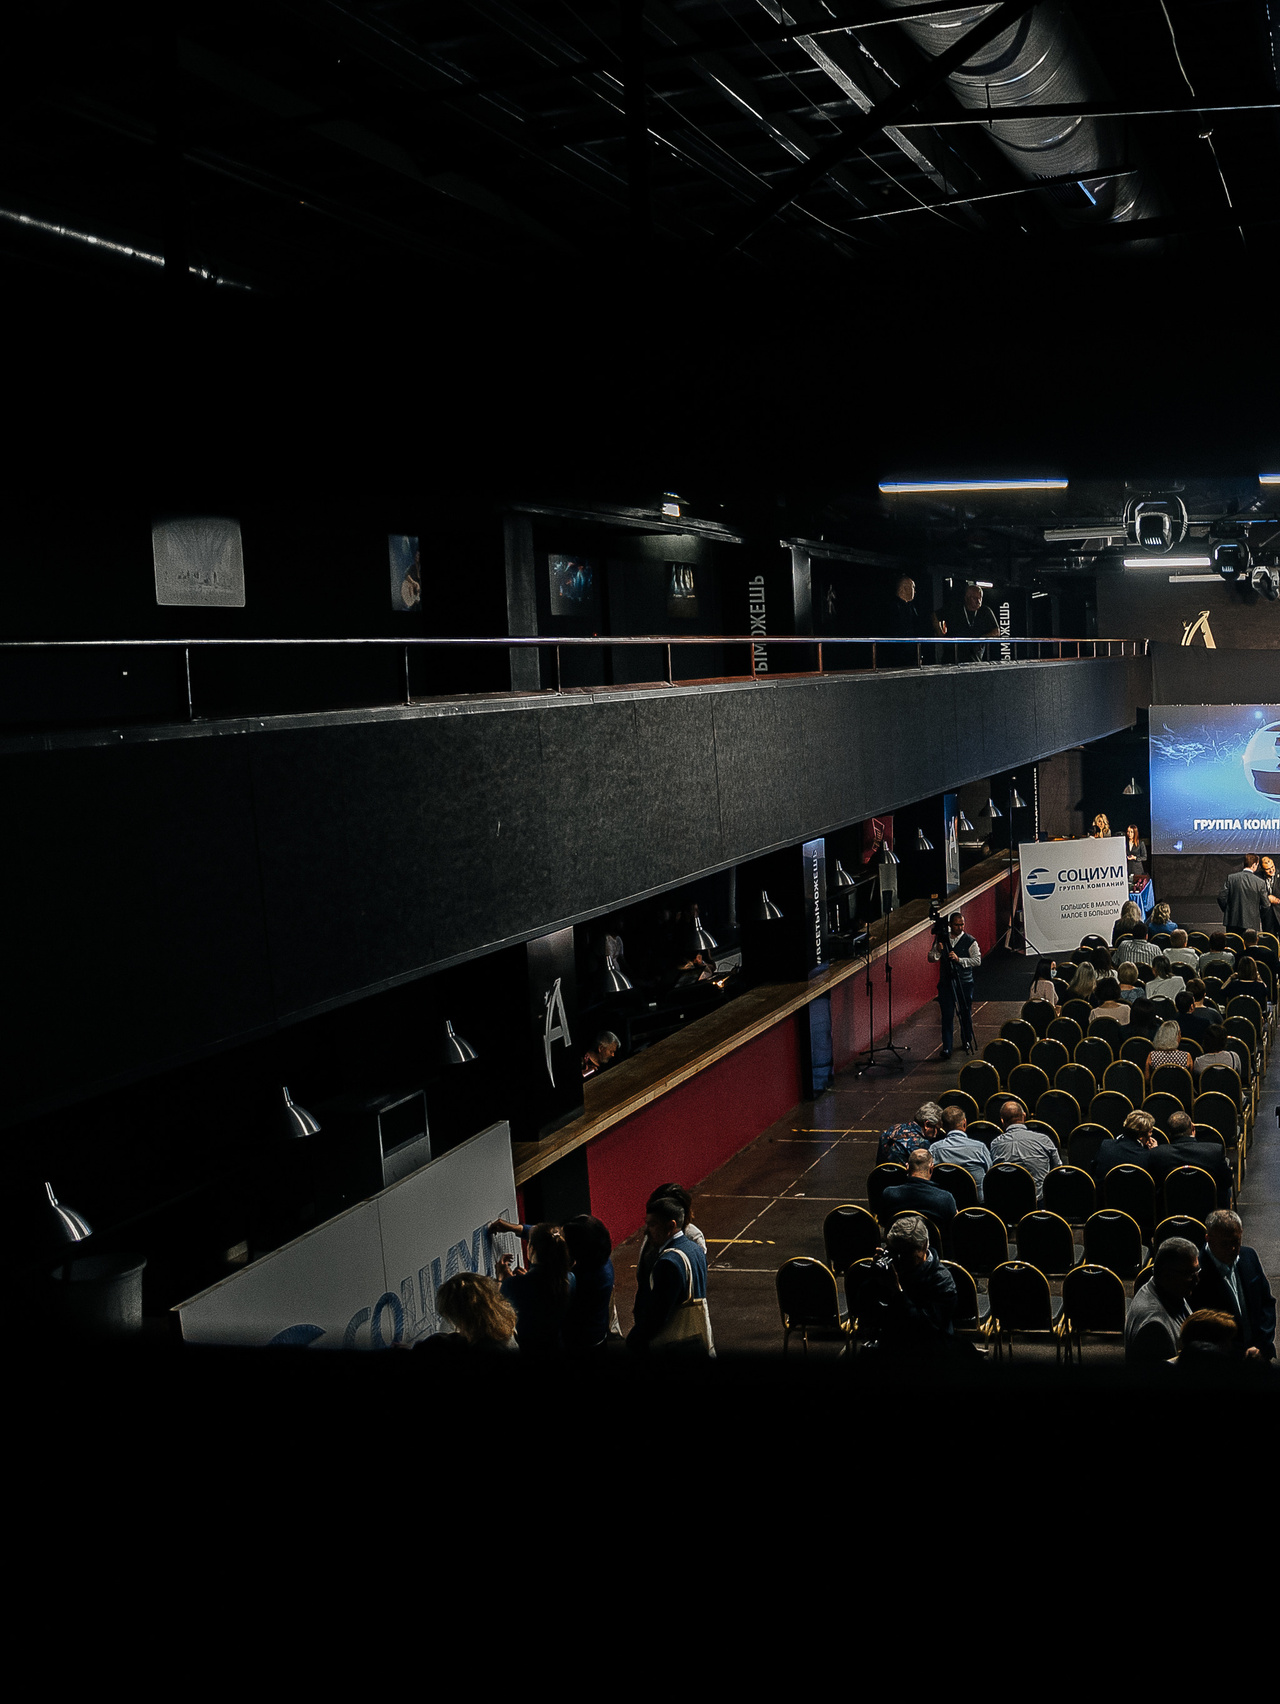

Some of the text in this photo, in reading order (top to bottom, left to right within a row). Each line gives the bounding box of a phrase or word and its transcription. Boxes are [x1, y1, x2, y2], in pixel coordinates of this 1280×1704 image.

[1000, 602, 1011, 661] ЫМЖЕШЬ
[1193, 819, 1242, 830] ГРУППА
[1058, 866, 1123, 883] СОЦИУМ
[1087, 881, 1125, 889] КОМПАНИЙ
[1061, 903, 1090, 911] БОЛЬШОЕ
[1088, 909, 1119, 917] БОЛЬШОМ
